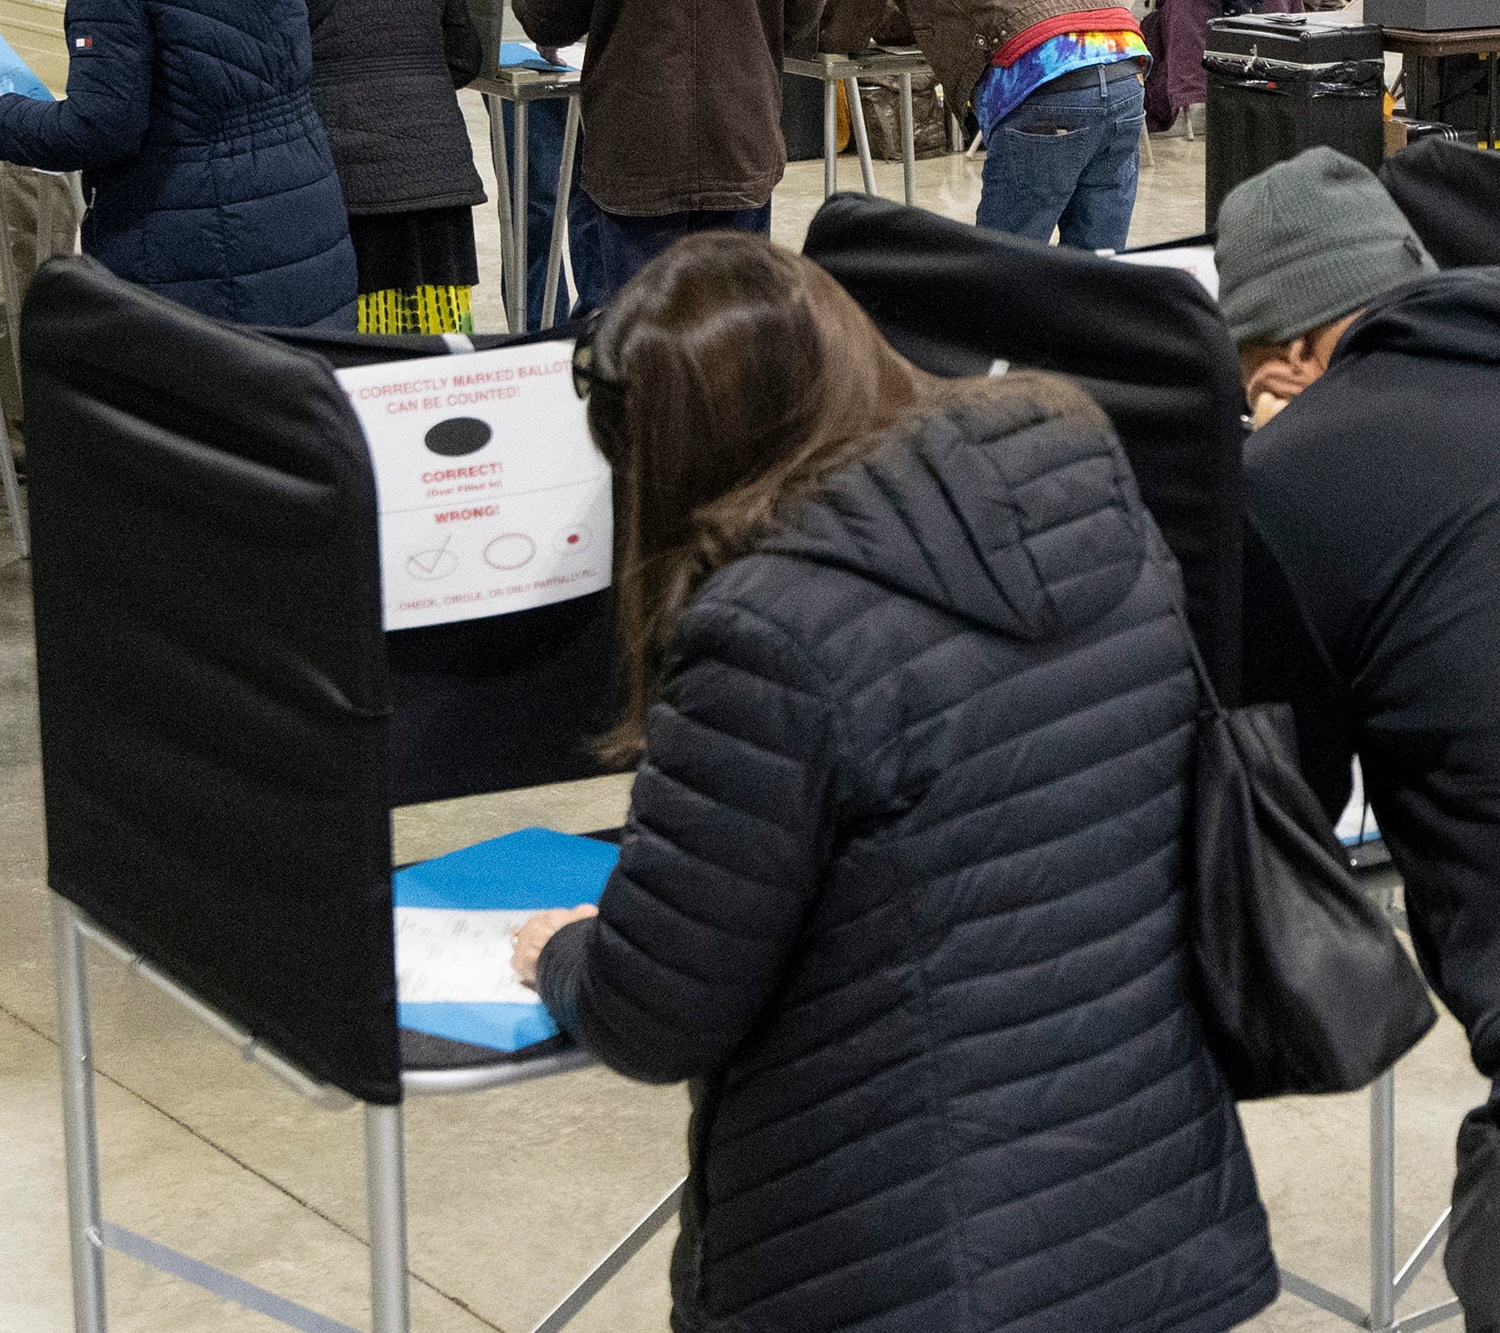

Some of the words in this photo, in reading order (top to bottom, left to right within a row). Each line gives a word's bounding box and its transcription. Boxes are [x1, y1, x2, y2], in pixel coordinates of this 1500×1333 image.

[359, 377, 448, 400] CORRECTLY
[452, 369, 514, 388] MARKED
[518, 359, 573, 379] BALLOT
[386, 400, 418, 414] CAN
[423, 397, 441, 410] BE
[447, 386, 520, 407] COUNTED!
[421, 462, 503, 484] CORRECT!
[434, 505, 500, 524] WRONG!
